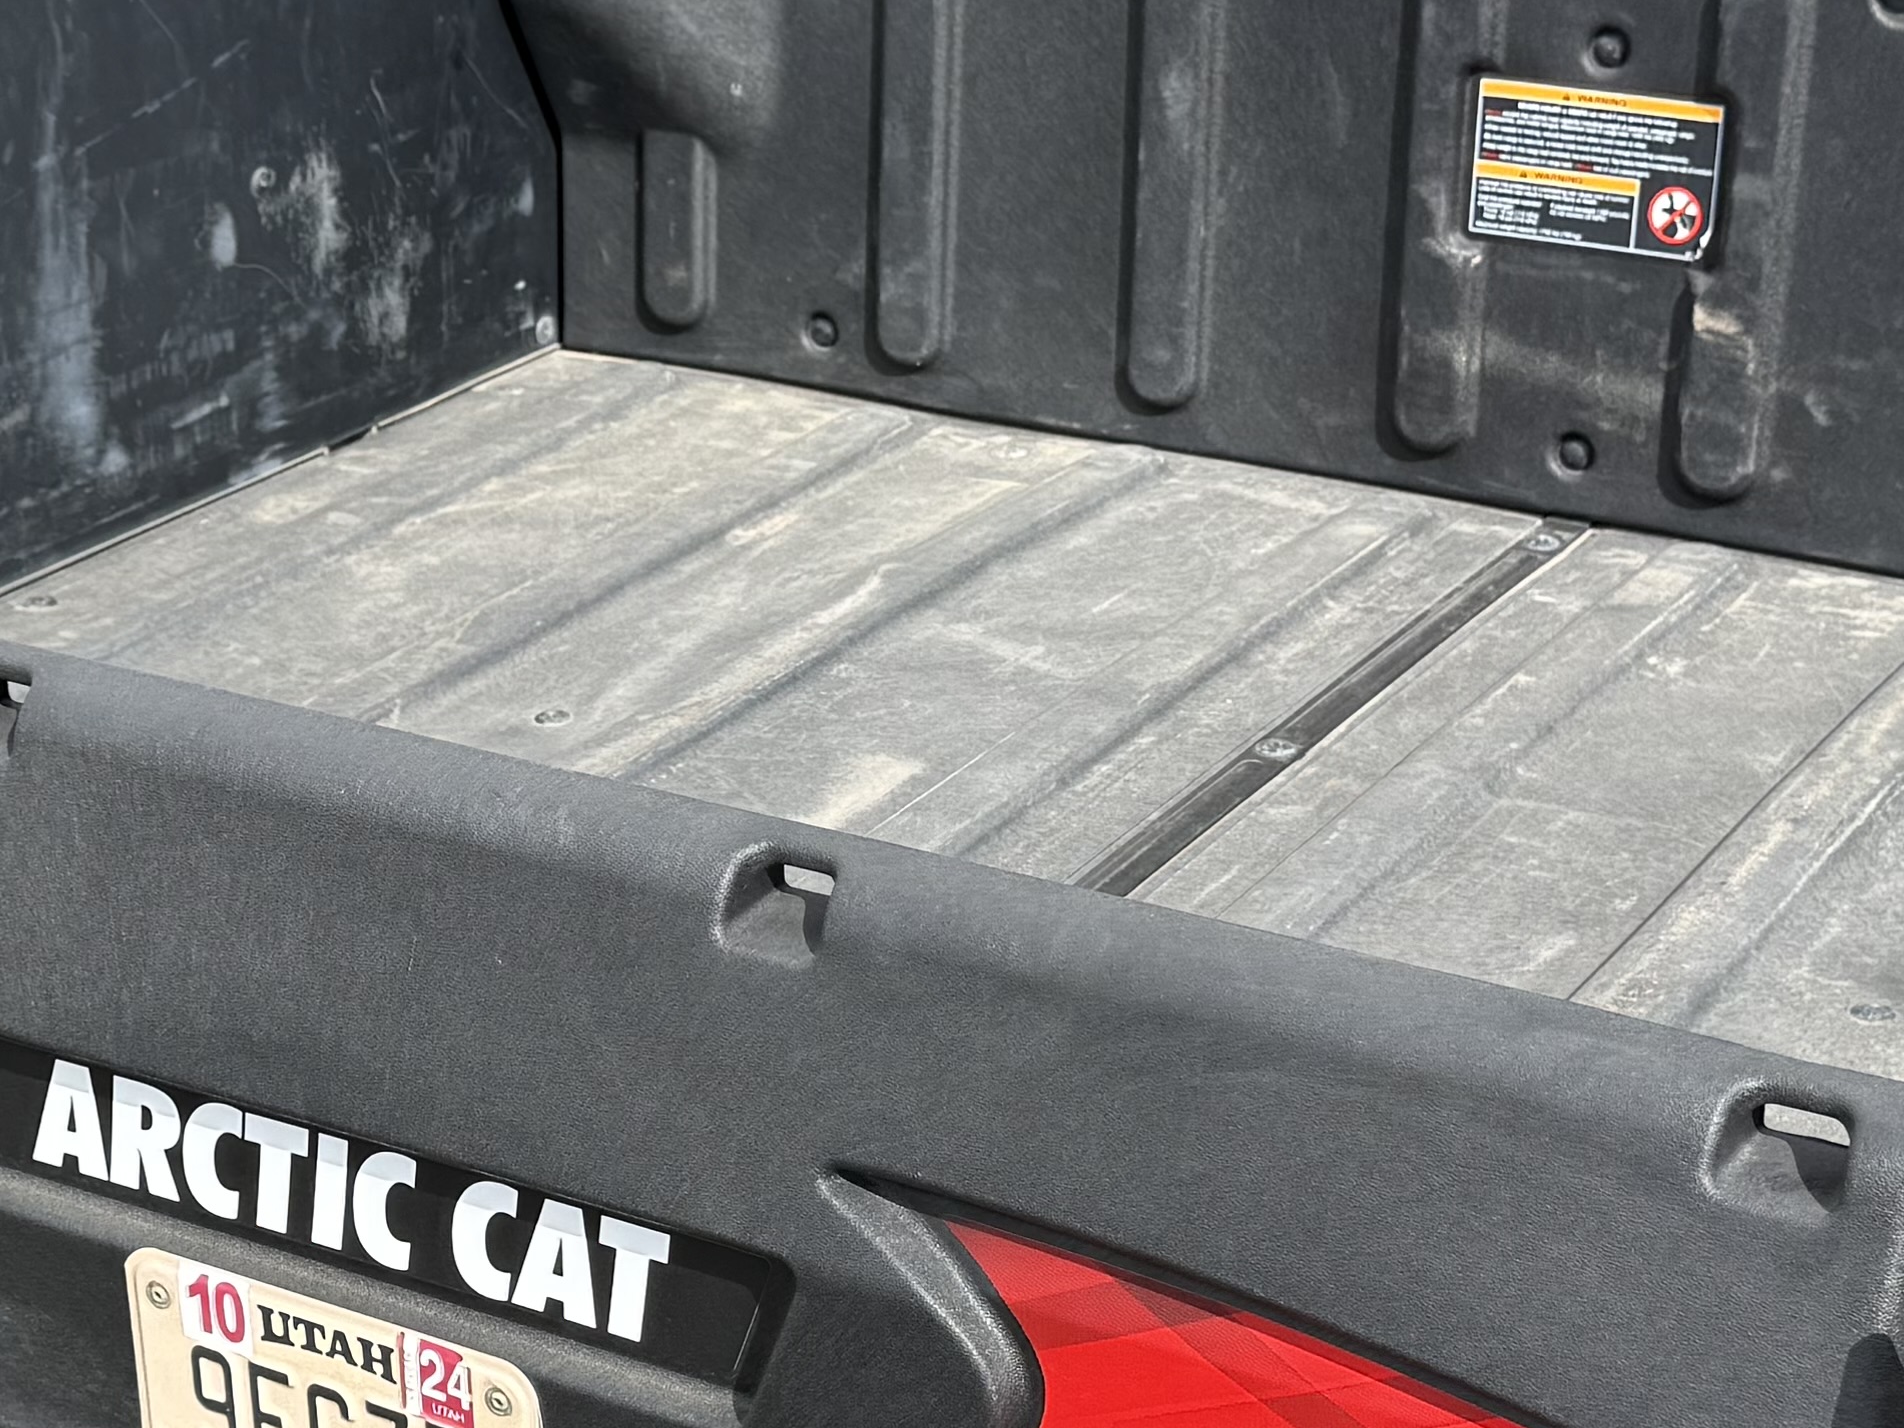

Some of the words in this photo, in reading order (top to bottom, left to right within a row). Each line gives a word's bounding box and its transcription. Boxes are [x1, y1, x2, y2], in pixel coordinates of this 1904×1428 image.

[33, 1058, 416, 1271] ARCTIC
[452, 1180, 670, 1343] CAT
[186, 1273, 245, 1344] 10
[256, 1304, 397, 1384] UTAH
[420, 1348, 472, 1411] 24
[431, 1401, 465, 1424] UTAH
